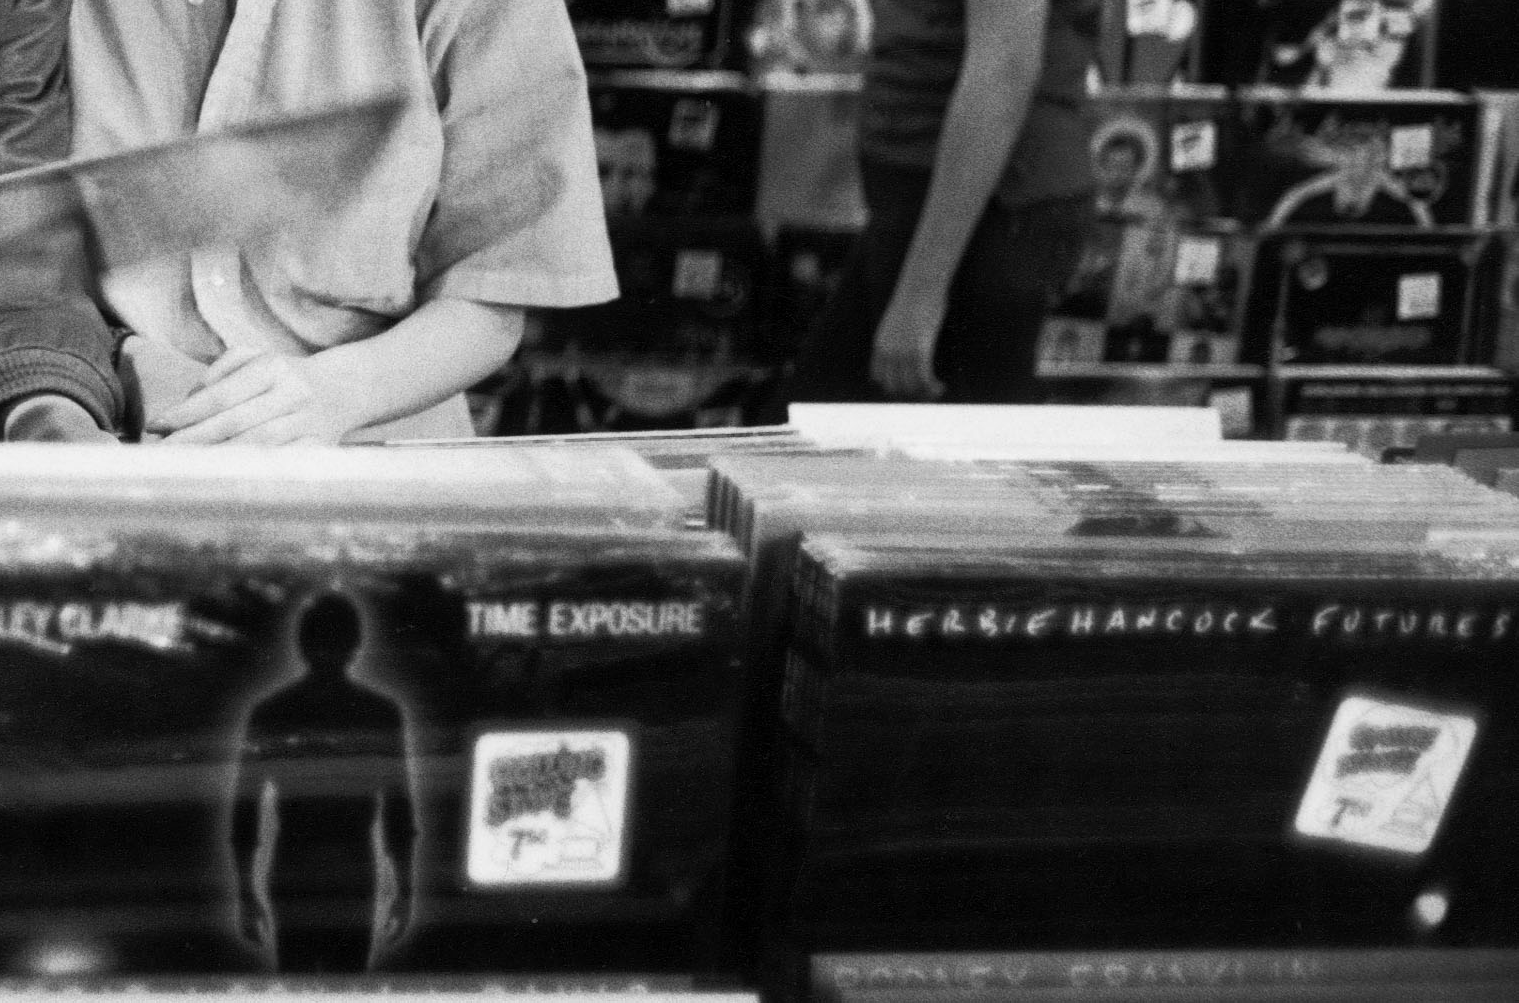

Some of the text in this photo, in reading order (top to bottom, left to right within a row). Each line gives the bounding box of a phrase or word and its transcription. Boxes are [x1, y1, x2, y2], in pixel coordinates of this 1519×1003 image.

[465, 599, 704, 638] TIME EXPOSURE
[865, 606, 1057, 638] HERBIE
[1069, 605, 1279, 637] HANCOCK
